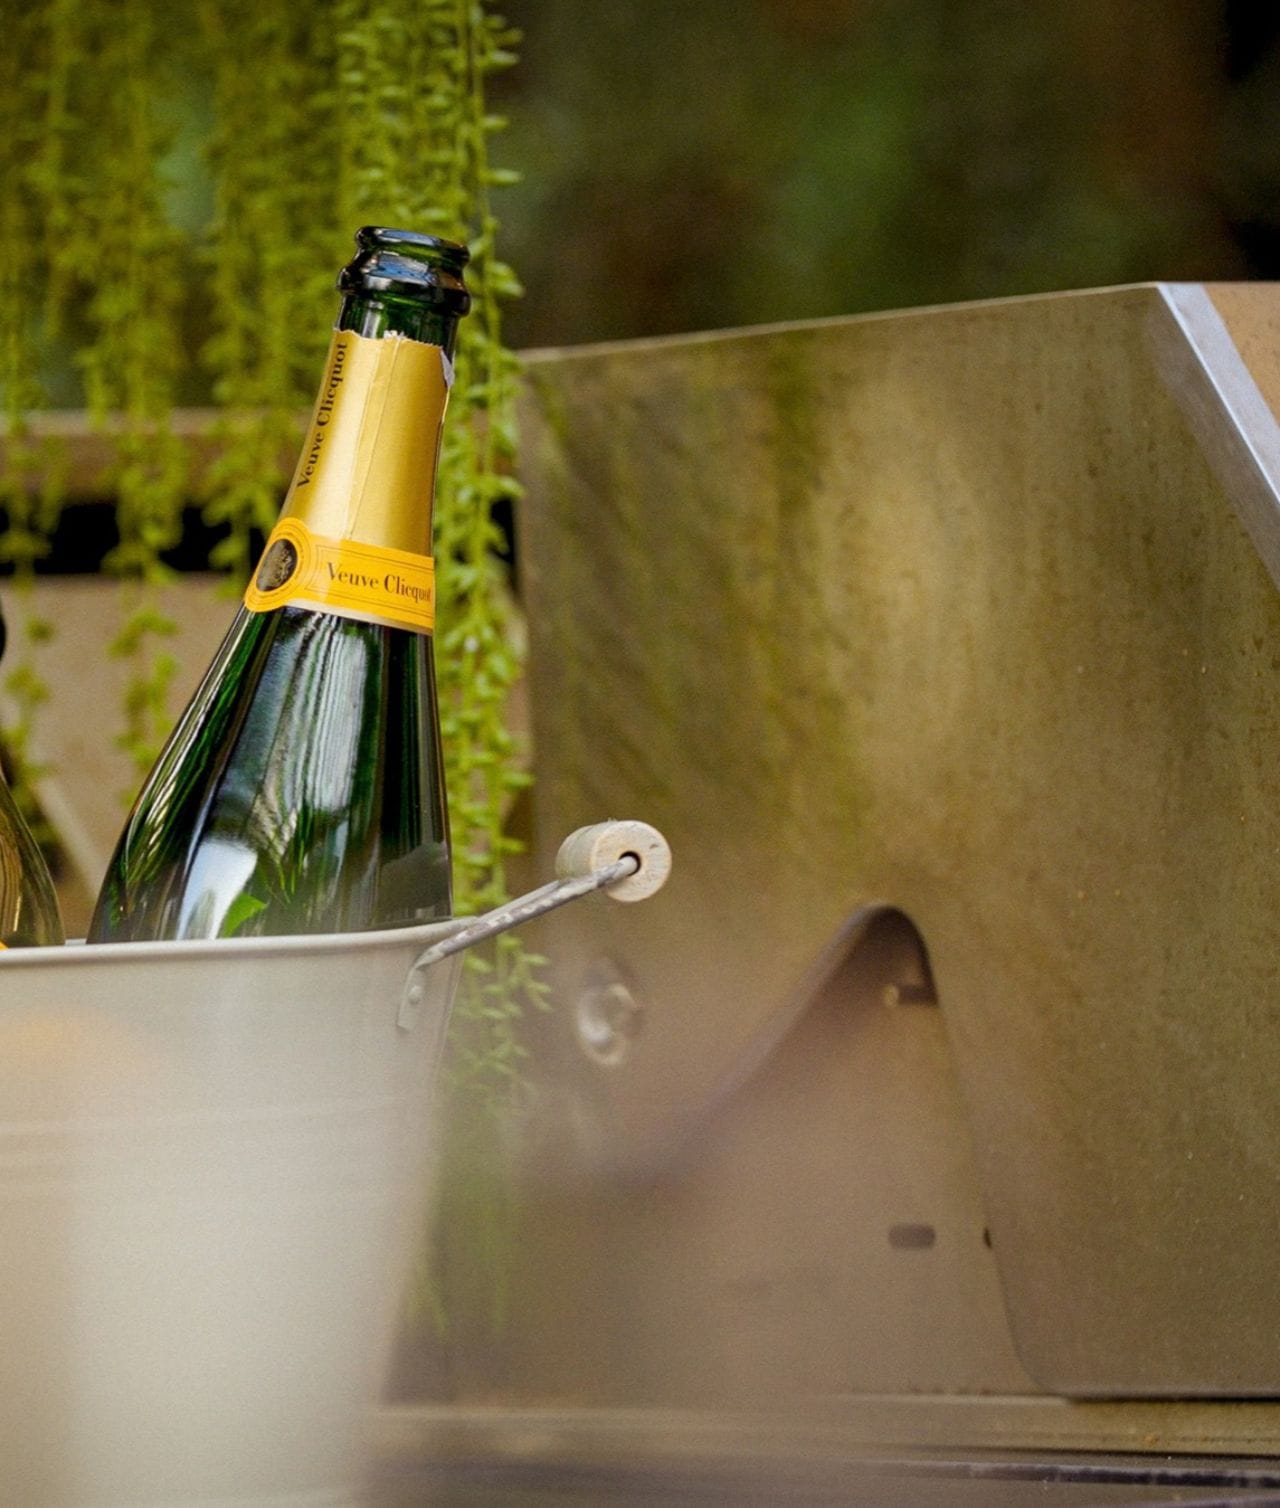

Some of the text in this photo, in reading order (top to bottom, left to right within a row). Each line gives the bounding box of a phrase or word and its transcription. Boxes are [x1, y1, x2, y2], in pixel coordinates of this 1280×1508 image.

[296, 341, 348, 488] Veuve Clicquot
[328, 561, 379, 590] Veuve
